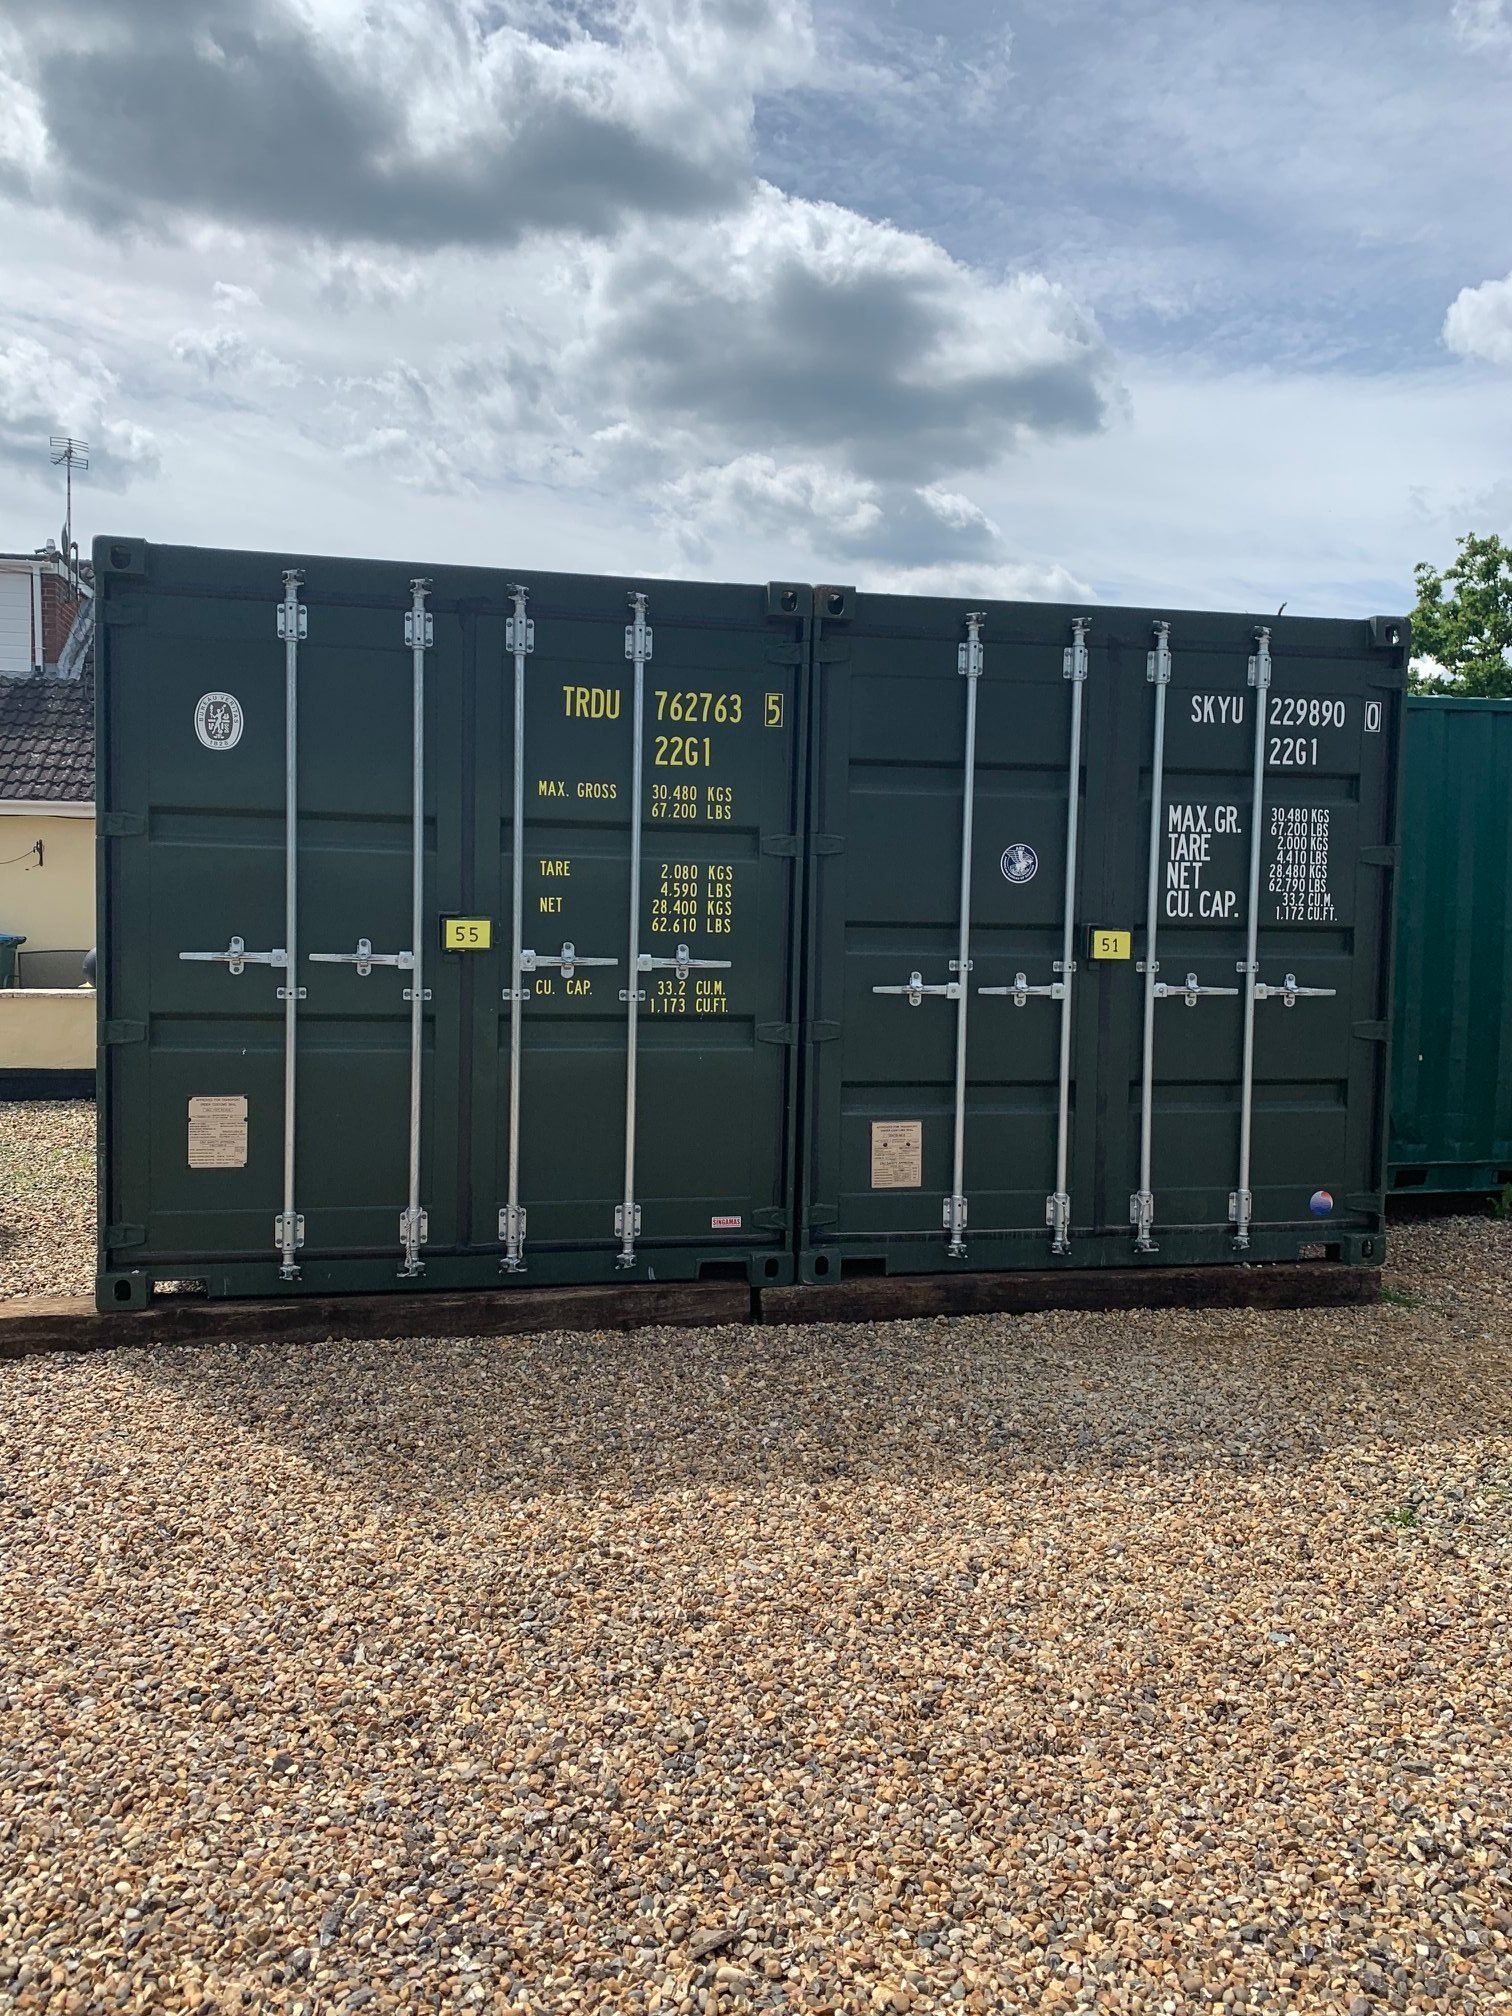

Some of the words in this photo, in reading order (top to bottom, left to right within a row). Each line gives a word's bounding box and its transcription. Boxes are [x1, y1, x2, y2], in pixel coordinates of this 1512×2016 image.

[563, 686, 621, 719] TRDU
[654, 690, 742, 723] 762763
[766, 695, 781, 726] 5
[1191, 695, 1244, 724] SKYU
[1269, 698, 1346, 727] 229890
[1366, 703, 1380, 730] 0
[654, 736, 710, 766] 22G1
[1269, 738, 1318, 765] 22G1
[538, 780, 570, 797] MAX.
[577, 782, 617, 799] GROSS
[652, 784, 697, 800] 30.480
[707, 786, 733, 802] KGS
[651, 802, 697, 819] 67.200
[706, 804, 732, 820] LBS
[1271, 808, 1308, 823] 30.480
[1311, 809, 1330, 823] KGS
[1270, 822, 1308, 836] 67.200
[1310, 823, 1329, 837] LBS
[1168, 834, 1211, 861] TARE
[1277, 836, 1307, 850] 2.000
[1310, 837, 1329, 851] KGS
[1276, 850, 1307, 864] 4.410
[1310, 851, 1328, 865] LBS
[540, 860, 571, 876] TARE
[661, 864, 698, 879] 2.080
[708, 865, 733, 880] KGS
[1167, 862, 1202, 889] NET
[1269, 864, 1306, 878] 28.480
[1309, 865, 1328, 879] KGS
[660, 882, 698, 897] 4.590
[707, 883, 732, 898] LBS
[1268, 878, 1306, 892] 62.790
[1308, 879, 1327, 893] LBS
[540, 897, 562, 912] NET
[652, 899, 697, 915] 28.400
[707, 900, 732, 915] KGS
[1166, 890, 1193, 917] CU.
[1200, 890, 1239, 918] CAP.
[1282, 893, 1304, 907] 33.2
[1276, 906, 1304, 920] 1.172
[651, 917, 697, 933] 62.610
[706, 918, 731, 933] LBS
[456, 926, 478, 942] 55
[1102, 938, 1118, 952] 51
[535, 980, 555, 995] CU.
[566, 980, 593, 995] CAP.
[657, 981, 686, 995] 33.2
[650, 998, 686, 1013] 1.173
